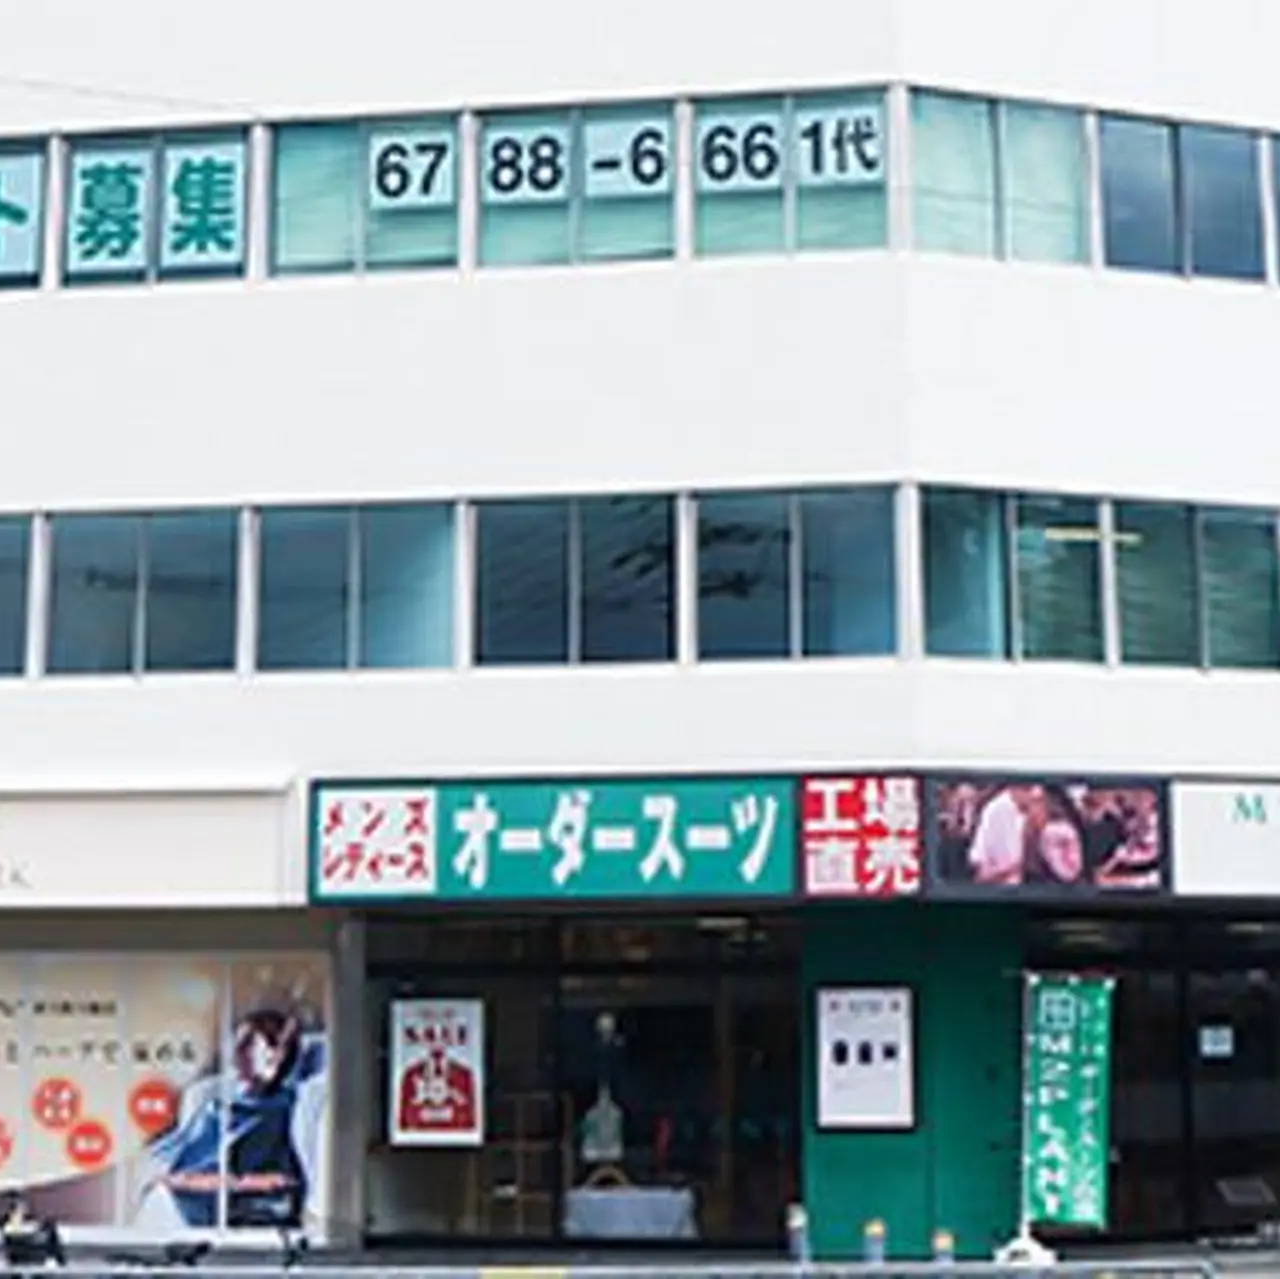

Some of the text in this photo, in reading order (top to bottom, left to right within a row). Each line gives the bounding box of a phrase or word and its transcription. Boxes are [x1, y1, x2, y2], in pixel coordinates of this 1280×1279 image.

[323, 798, 430, 838] メンズ
[805, 778, 920, 833] 工場
[453, 789, 778, 889] オーダースーツ
[805, 836, 920, 894] 直売
